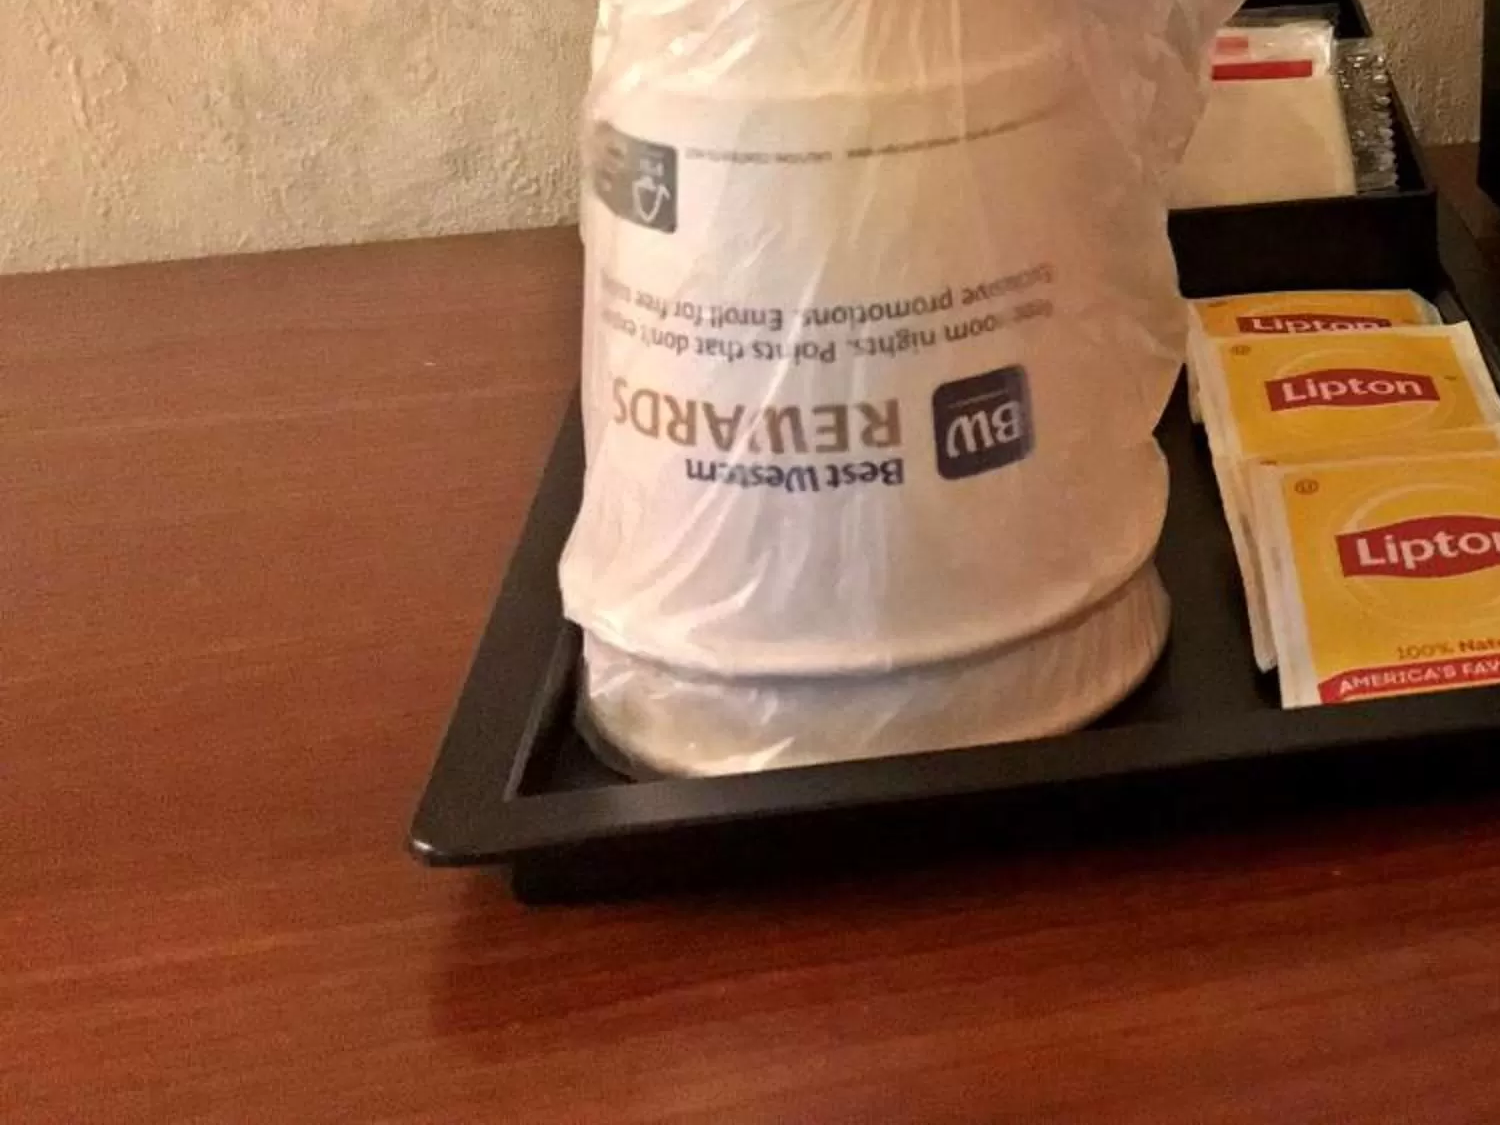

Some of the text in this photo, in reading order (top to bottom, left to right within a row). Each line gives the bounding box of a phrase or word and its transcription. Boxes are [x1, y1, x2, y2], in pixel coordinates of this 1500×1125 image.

[674, 299, 704, 327] for
[711, 304, 783, 332] Enroll
[1252, 317, 1382, 334] Lipton
[943, 313, 1008, 342] oom
[695, 335, 744, 363] that
[1282, 376, 1424, 402] Lipton
[613, 374, 900, 454] REWARDS
[945, 399, 1024, 460] BW
[825, 457, 905, 490] Best
[1397, 644, 1454, 660] 100%
[1338, 664, 1457, 694] AMERICA'S
